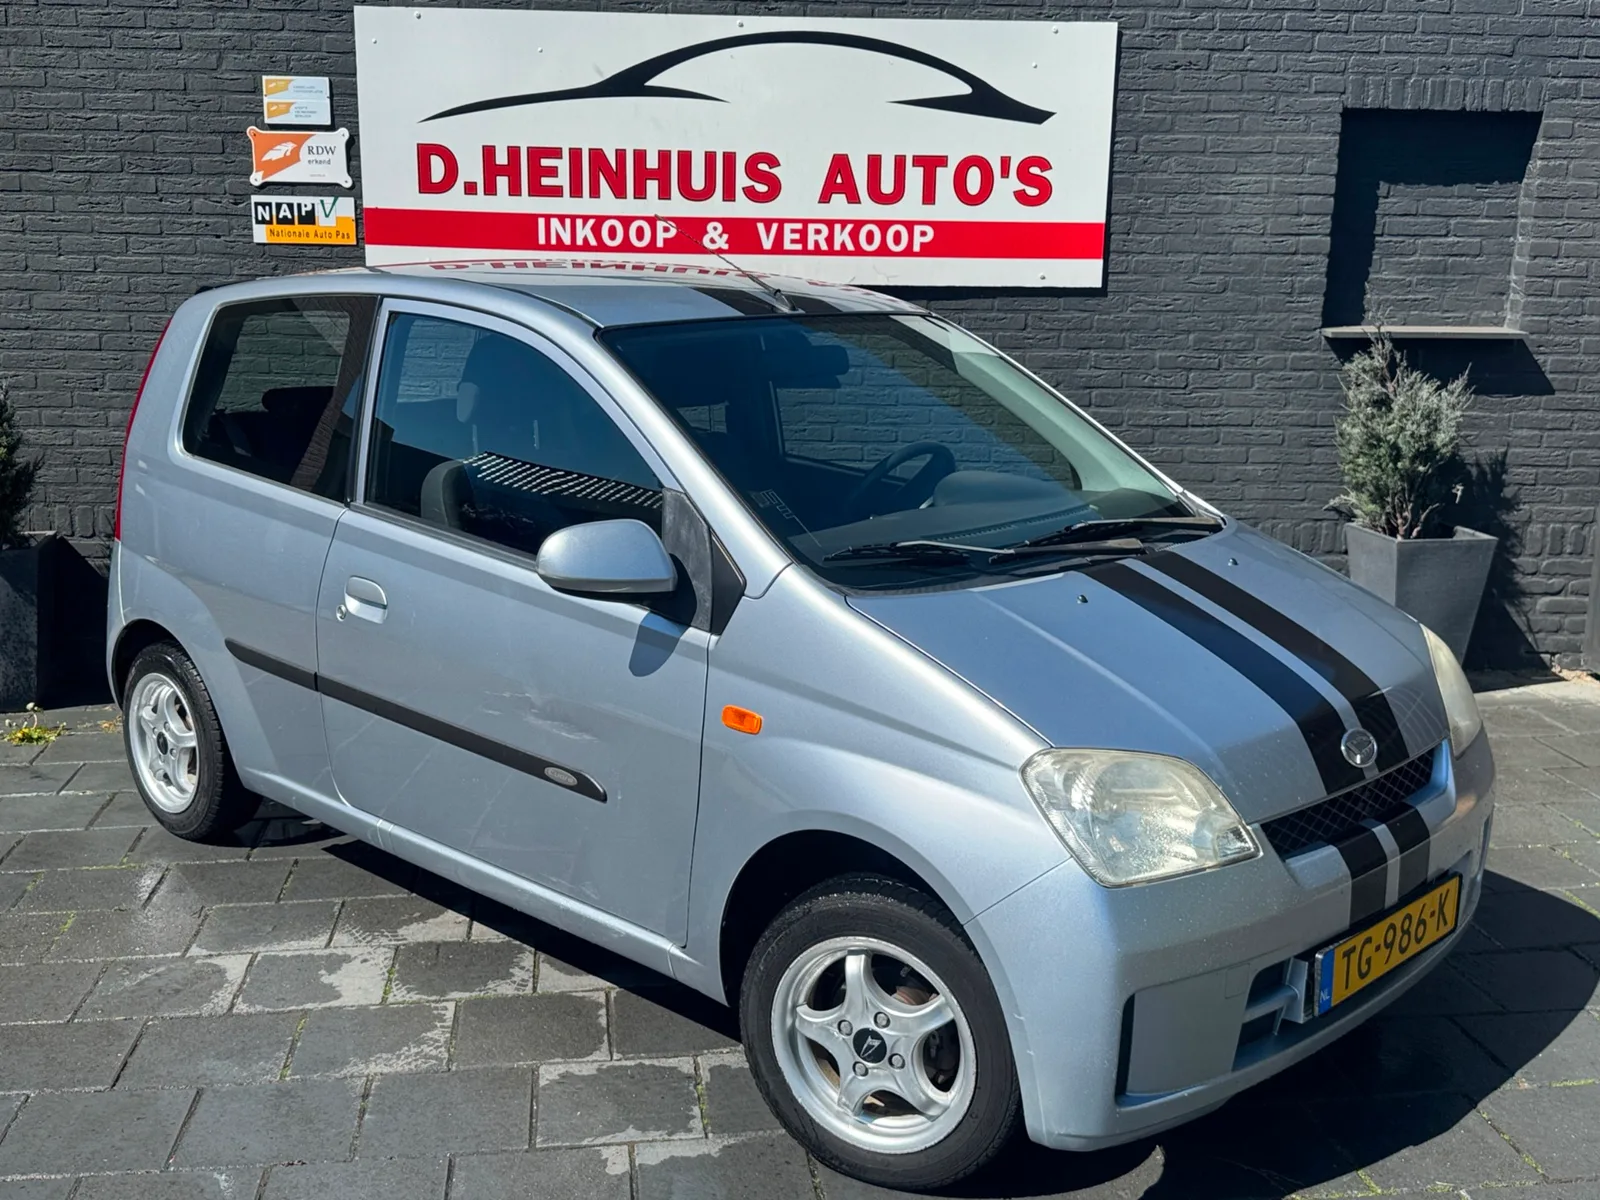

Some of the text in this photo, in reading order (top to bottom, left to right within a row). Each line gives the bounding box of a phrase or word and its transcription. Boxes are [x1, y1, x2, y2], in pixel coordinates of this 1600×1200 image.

[307, 145, 337, 156] RDW
[307, 158, 332, 166] erkend
[416, 142, 1054, 207] D.HEINHUIS AUTO'S
[269, 228, 351, 240] Nationale Auto Pas
[537, 217, 936, 253] INKOOP & VERKOOP
[1342, 888, 1450, 990] TG-986-K
[1319, 987, 1331, 1004] NL
